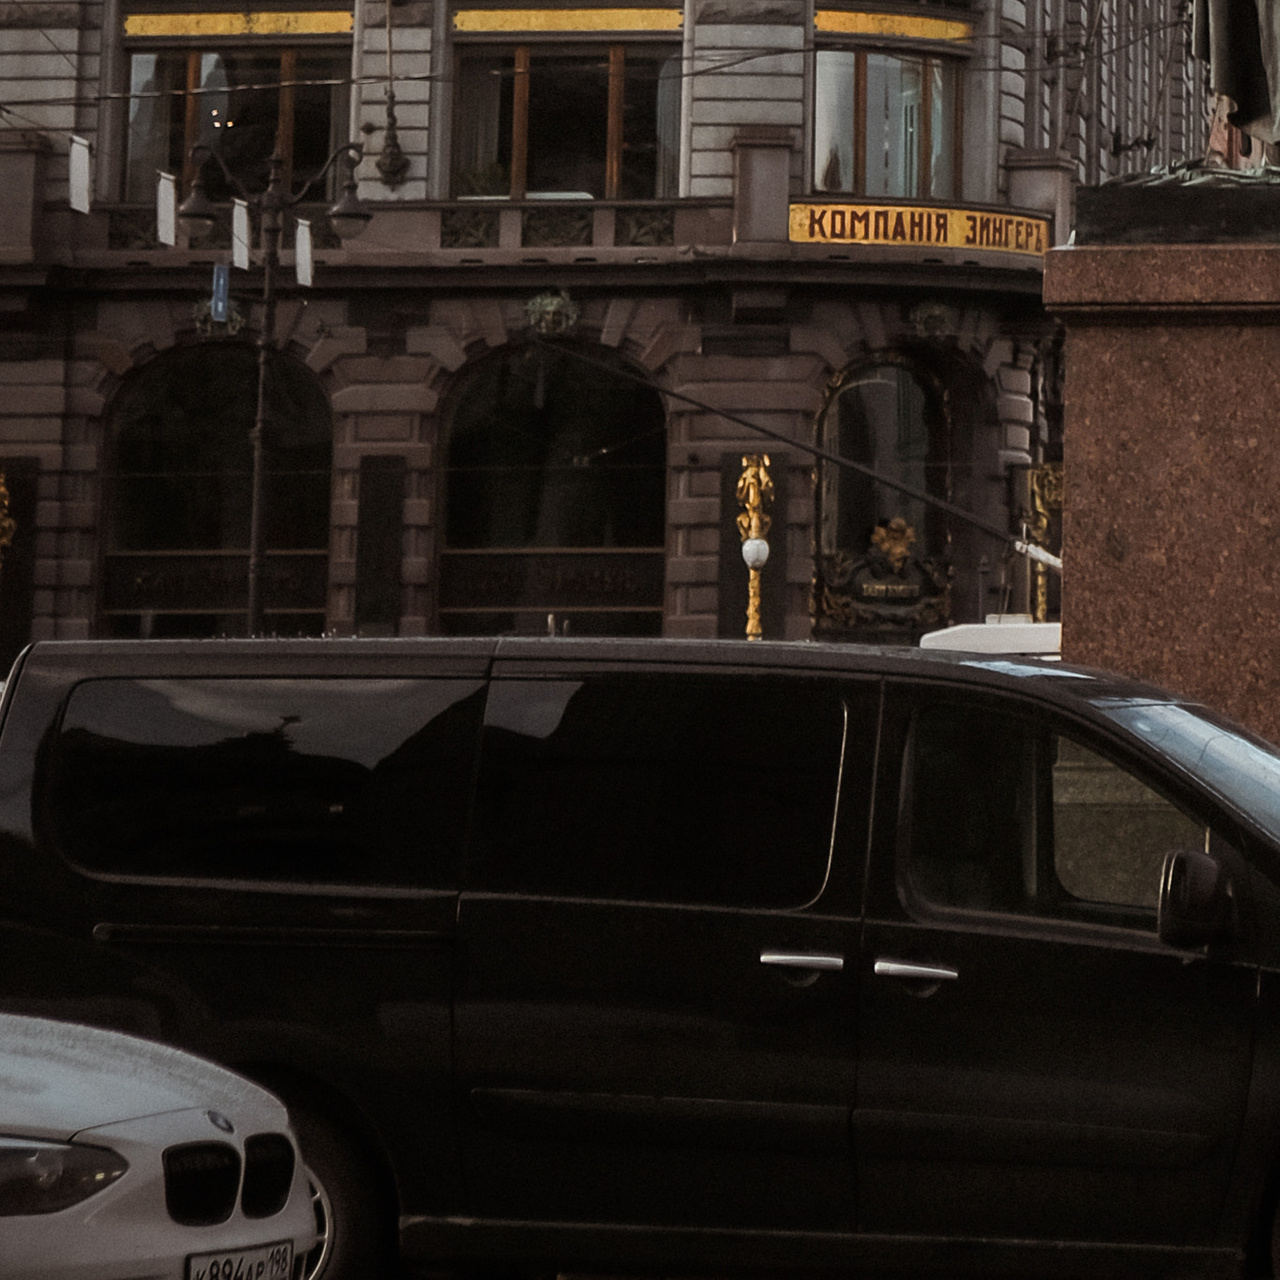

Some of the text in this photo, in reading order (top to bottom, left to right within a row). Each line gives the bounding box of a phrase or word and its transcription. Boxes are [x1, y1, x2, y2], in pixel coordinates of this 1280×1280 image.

[808, 209, 1043, 253] КОМПАНІЯ ЗИНГЕРЪ
[268, 1246, 288, 1275] 198
